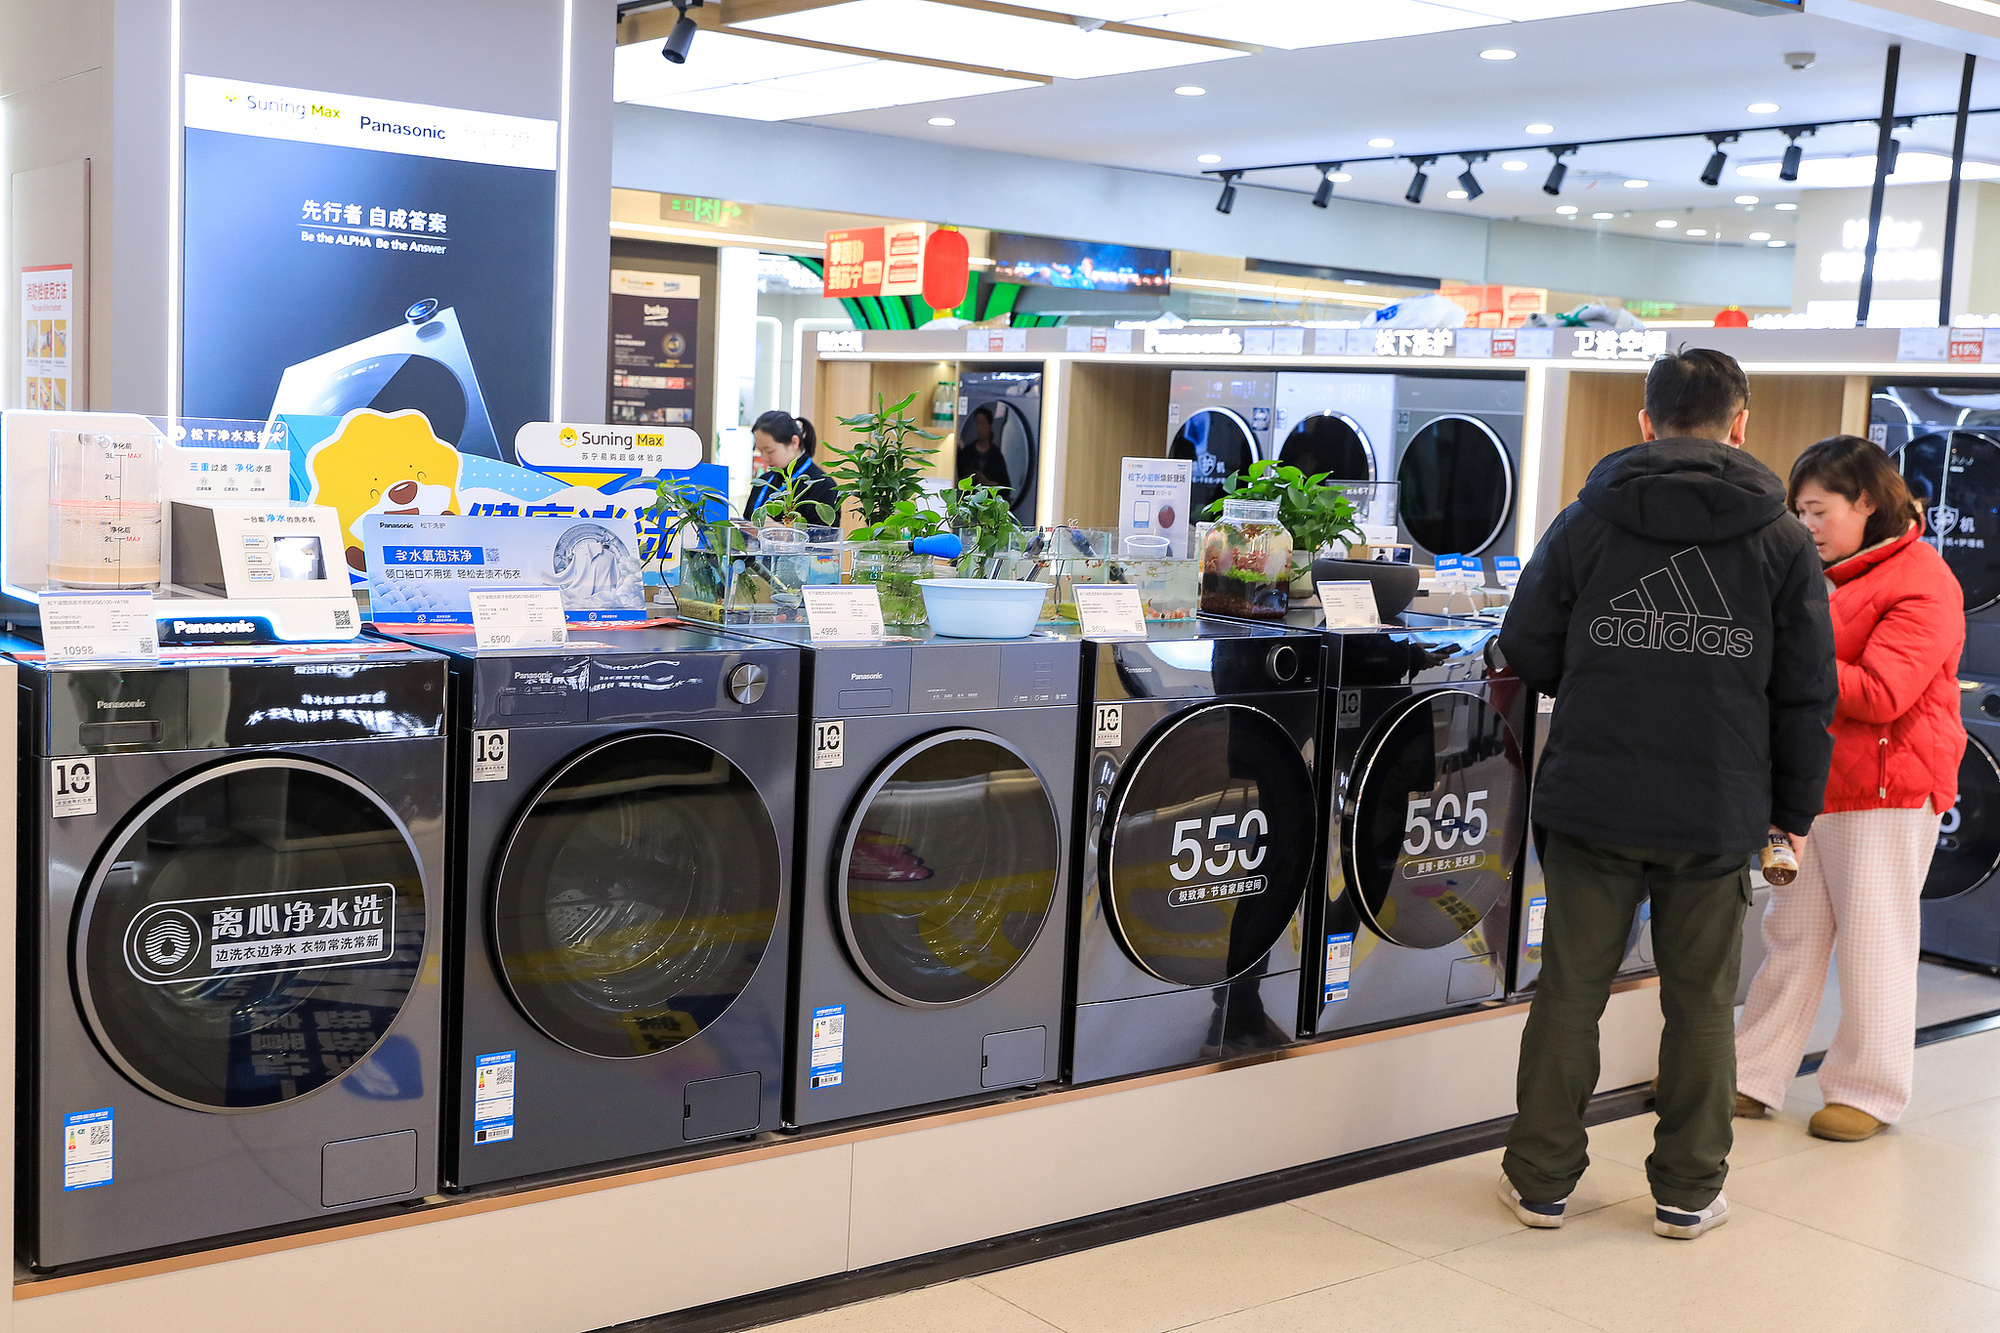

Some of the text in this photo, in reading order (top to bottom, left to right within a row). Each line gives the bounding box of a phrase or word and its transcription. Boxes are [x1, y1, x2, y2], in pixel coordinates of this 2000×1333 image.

[247, 95, 341, 119] Suning Max
[360, 115, 446, 140] Panasonic
[302, 199, 448, 234] 先行者 自成答案
[301, 230, 447, 255] Be the ALPHA Be the Answer
[643, 304, 670, 316] beko
[1144, 327, 1242, 353] Panasonic
[1376, 328, 1454, 356] 松下洗护
[582, 430, 662, 450] Suning Max
[190, 462, 272, 473] 三重过滤 净化水质
[582, 452, 663, 464] 苏宁易购超级体验店
[243, 514, 316, 523] 一台能净水的洗衣机
[408, 550, 472, 563] 水氧泡沫净
[385, 568, 522, 580] 领口袖口不用搓 轻松去渍不伤衣
[174, 620, 256, 635] Panasonic
[1590, 610, 1753, 658] adidas
[63, 646, 94, 655] 10998
[490, 635, 511, 644] 6900
[514, 670, 553, 680] Panasonic
[850, 672, 884, 681] Panasonic
[96, 698, 146, 710] Panasonic
[1341, 692, 1358, 714] 10
[1099, 708, 1118, 731] 10
[477, 734, 504, 762] 10
[818, 725, 840, 750] 10
[56, 763, 90, 795] 10
[1403, 790, 1488, 856] 505
[1169, 809, 1268, 882] 550
[1417, 855, 1477, 874] 更薄·更大·更安静
[1178, 880, 1262, 903] 极致薄·节省家居空间
[211, 894, 385, 941] 离心净水洗
[216, 934, 380, 964] 边洗衣边净水 衣物常洗常新
